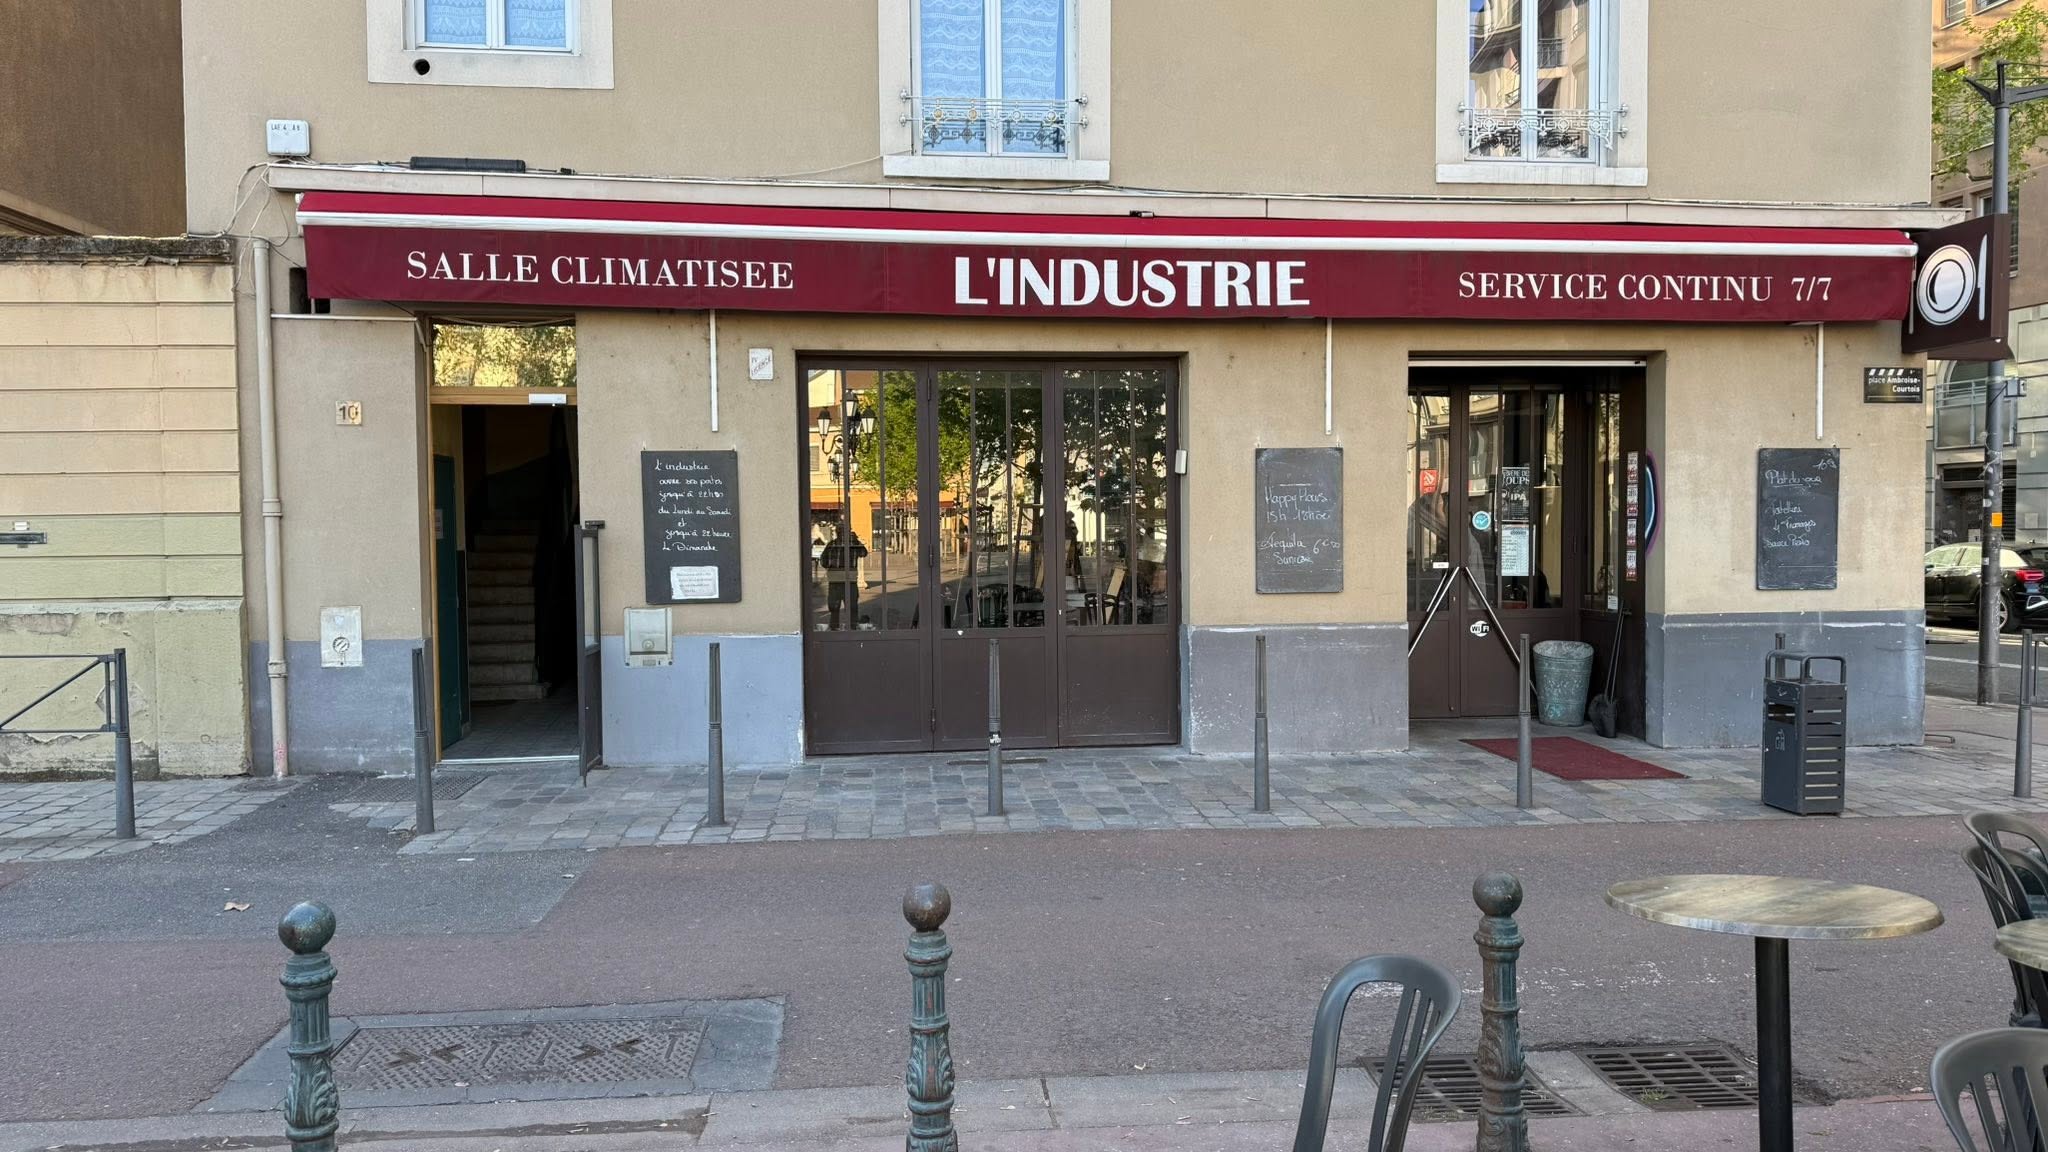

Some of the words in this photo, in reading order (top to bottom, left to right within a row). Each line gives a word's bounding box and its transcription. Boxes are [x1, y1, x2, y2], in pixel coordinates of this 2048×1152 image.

[407, 251, 539, 283] SALLE
[551, 256, 793, 290] CLIMATISEE
[955, 256, 1310, 307] L'INDUSTRIE
[1459, 272, 1607, 300] SERVICE
[1618, 274, 1773, 302] CONTINU
[1791, 277, 1832, 302] 7/7
[1868, 376, 1886, 385] place
[1887, 376, 1921, 384] Ambroise-
[1892, 384, 1921, 393] Courtois
[339, 405, 359, 421] 10
[700, 475, 723, 488] portes
[1764, 469, 1788, 485] Plat
[1788, 470, 1800, 484] du
[1264, 486, 1298, 511] Happy
[1510, 493, 1527, 501] IPA
[658, 505, 670, 515] du
[677, 517, 687, 527] et
[1260, 530, 1307, 553] Tequila
